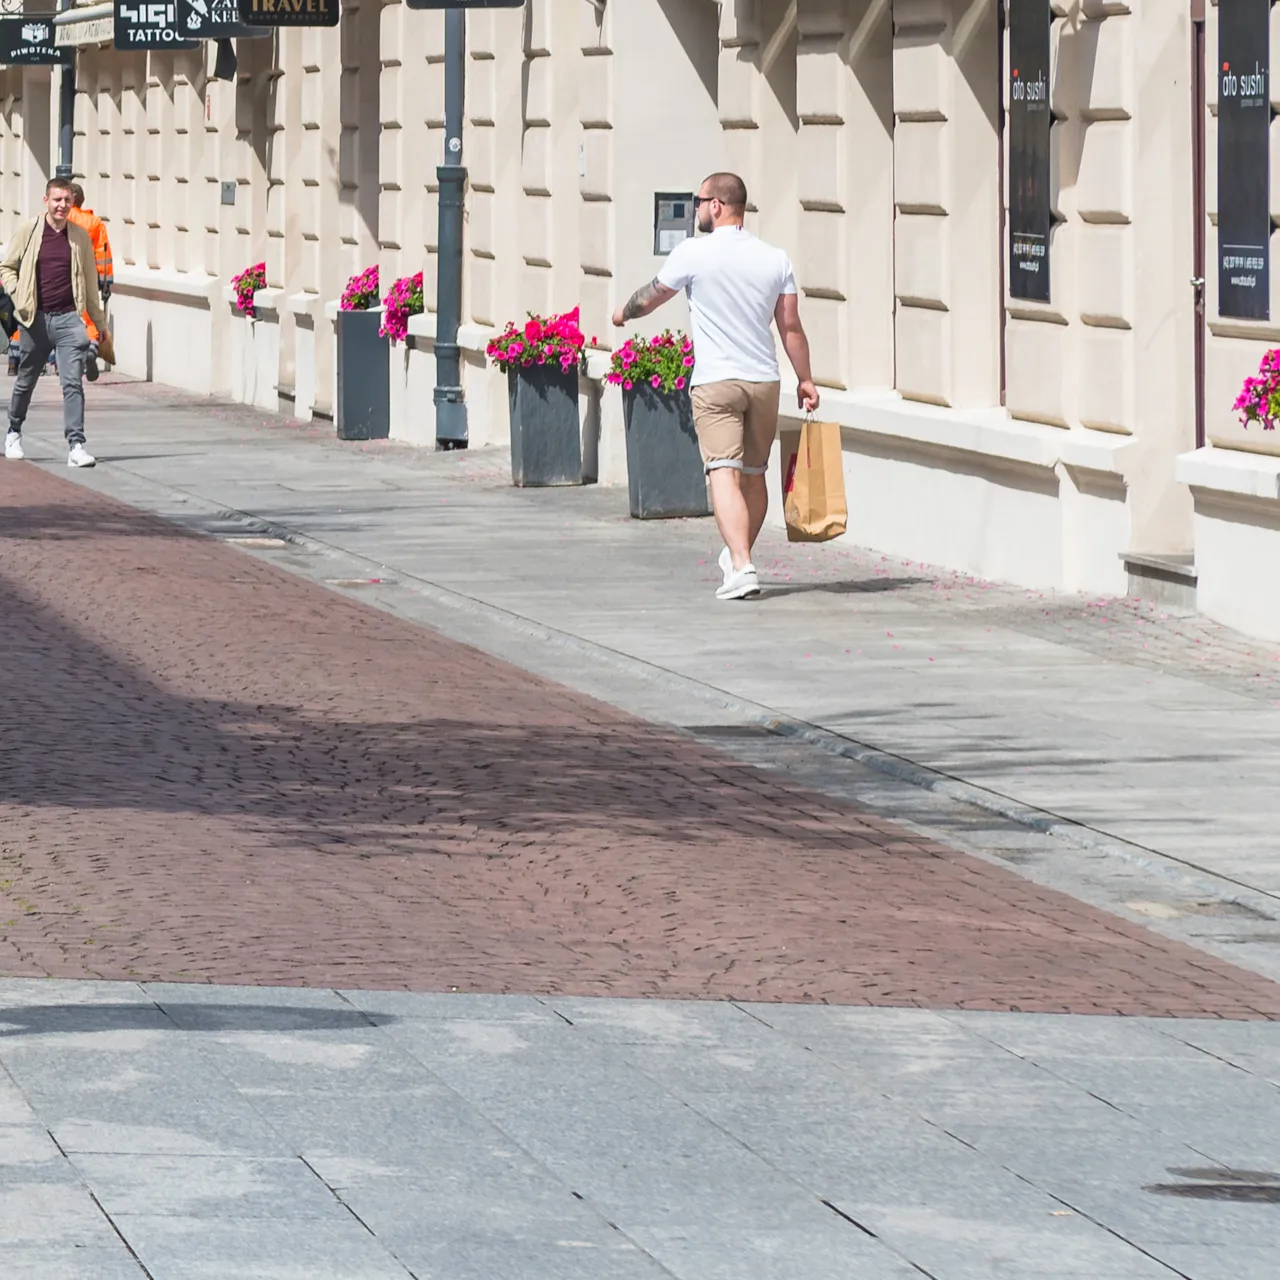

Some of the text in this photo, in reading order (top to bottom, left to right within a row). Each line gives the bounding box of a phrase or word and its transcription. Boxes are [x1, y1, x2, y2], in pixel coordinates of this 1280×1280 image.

[10, 46, 61, 58] PIWOTEKA
[1026, 69, 1046, 101] sushi
[1240, 61, 1265, 96] sushi
